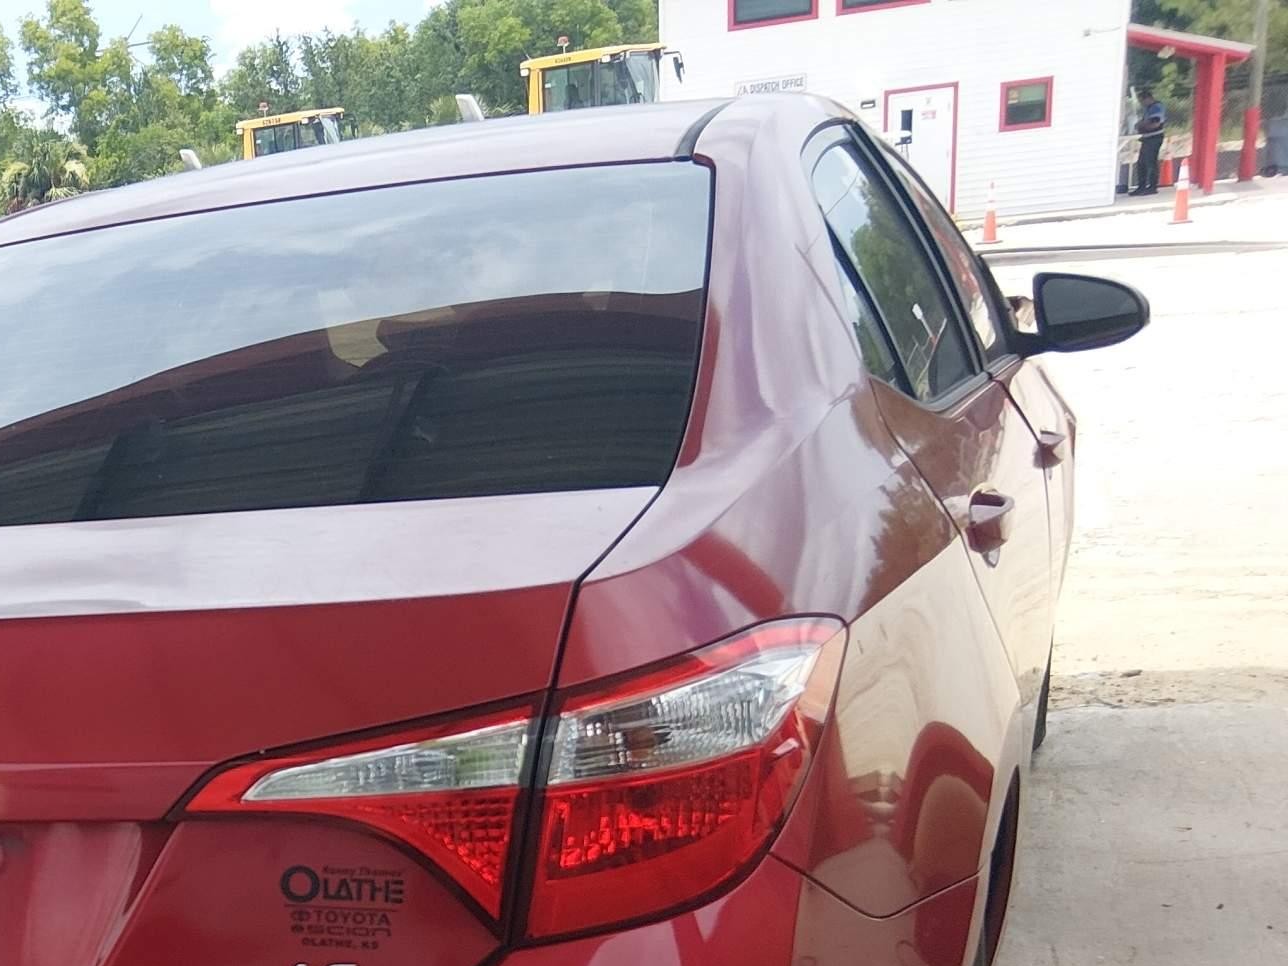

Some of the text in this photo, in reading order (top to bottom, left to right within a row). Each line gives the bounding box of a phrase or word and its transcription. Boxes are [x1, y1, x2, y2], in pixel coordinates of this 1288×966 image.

[749, 80, 780, 95] DISPATCH
[781, 76, 804, 89] OFFICE
[280, 866, 404, 904] OLATHE
[314, 910, 391, 926] TOYOTA
